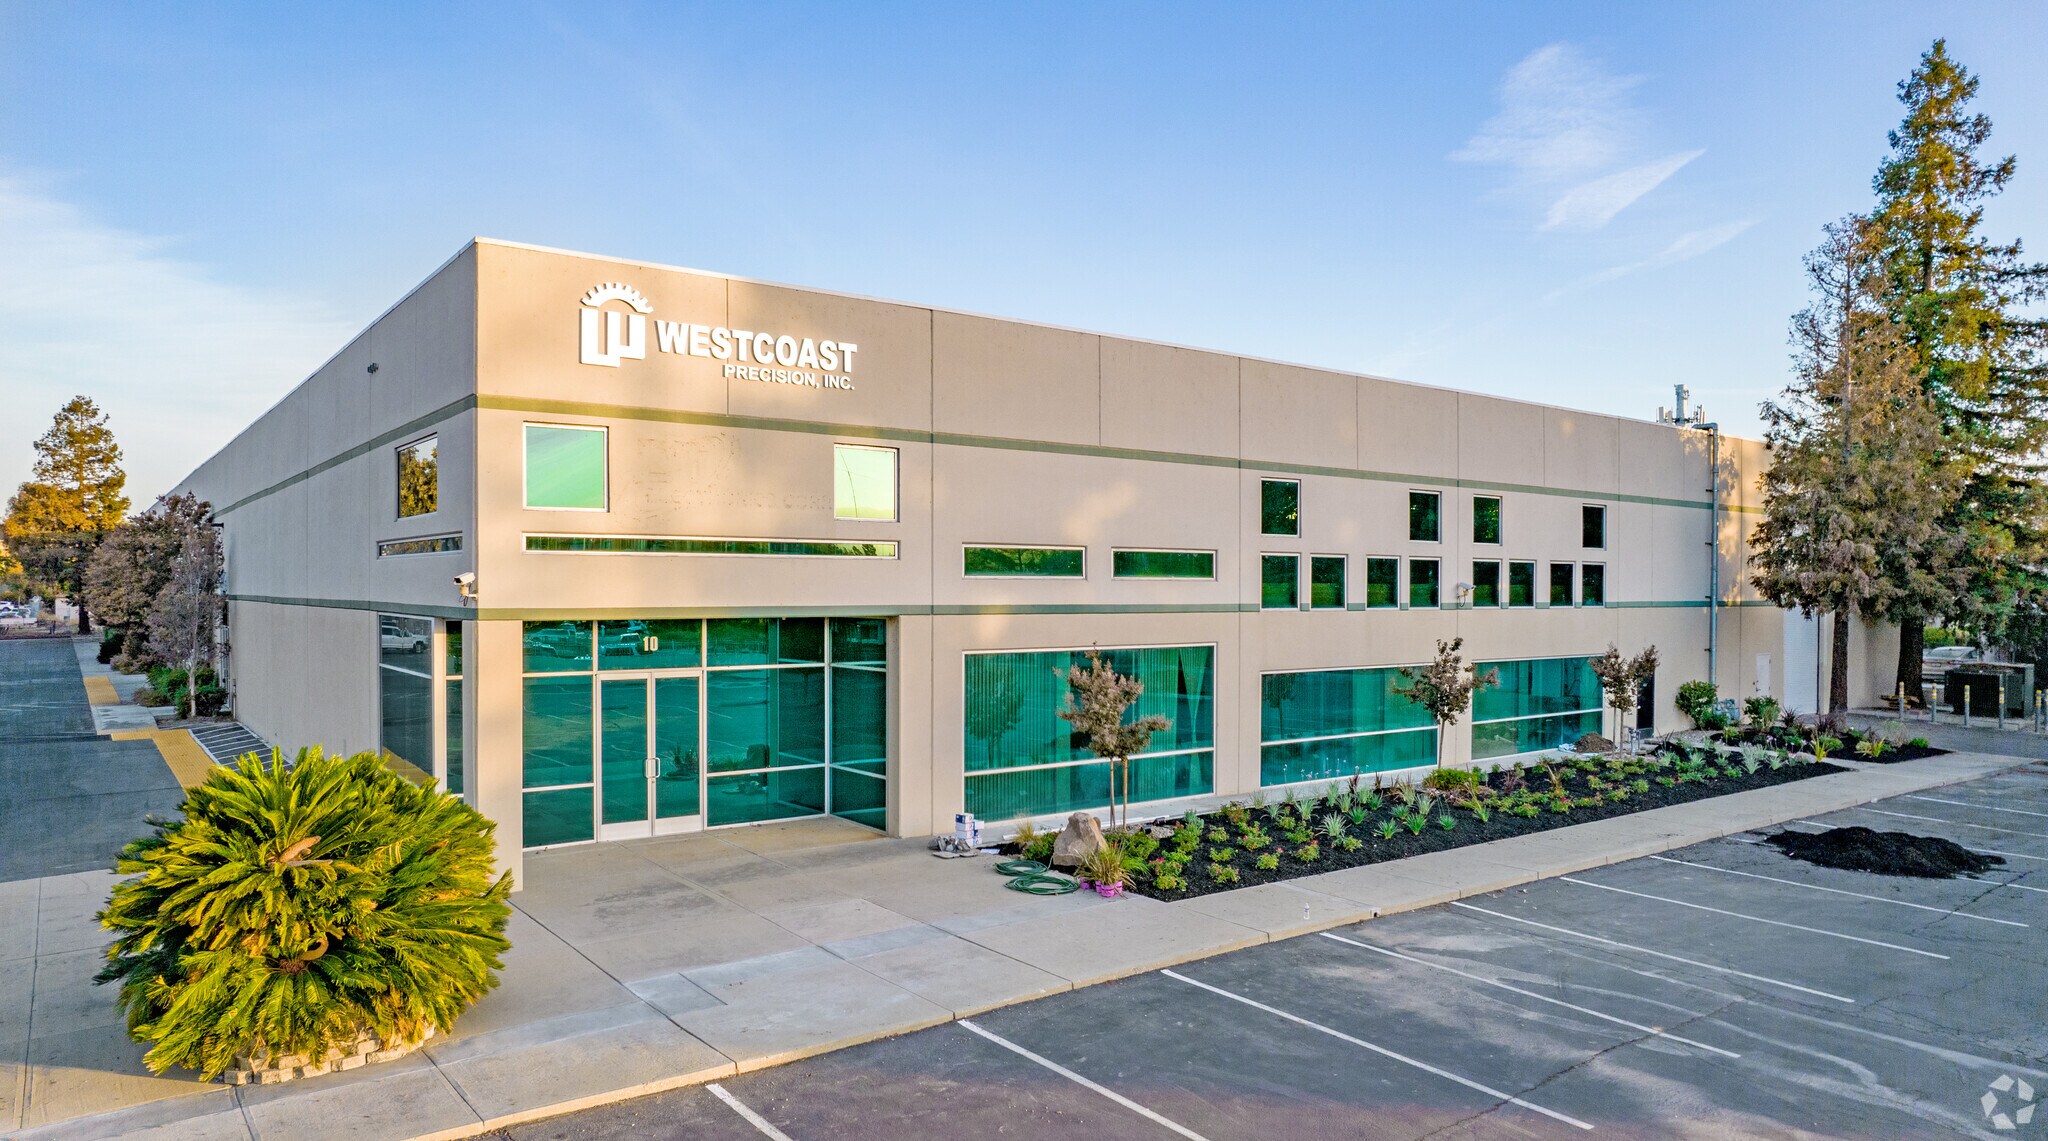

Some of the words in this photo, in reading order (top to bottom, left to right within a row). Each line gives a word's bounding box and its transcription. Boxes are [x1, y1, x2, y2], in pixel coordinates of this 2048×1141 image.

[656, 320, 857, 373] WESTCOAST
[724, 364, 820, 389] PRECISION,
[824, 375, 855, 390] INC.
[643, 636, 658, 651] 10
